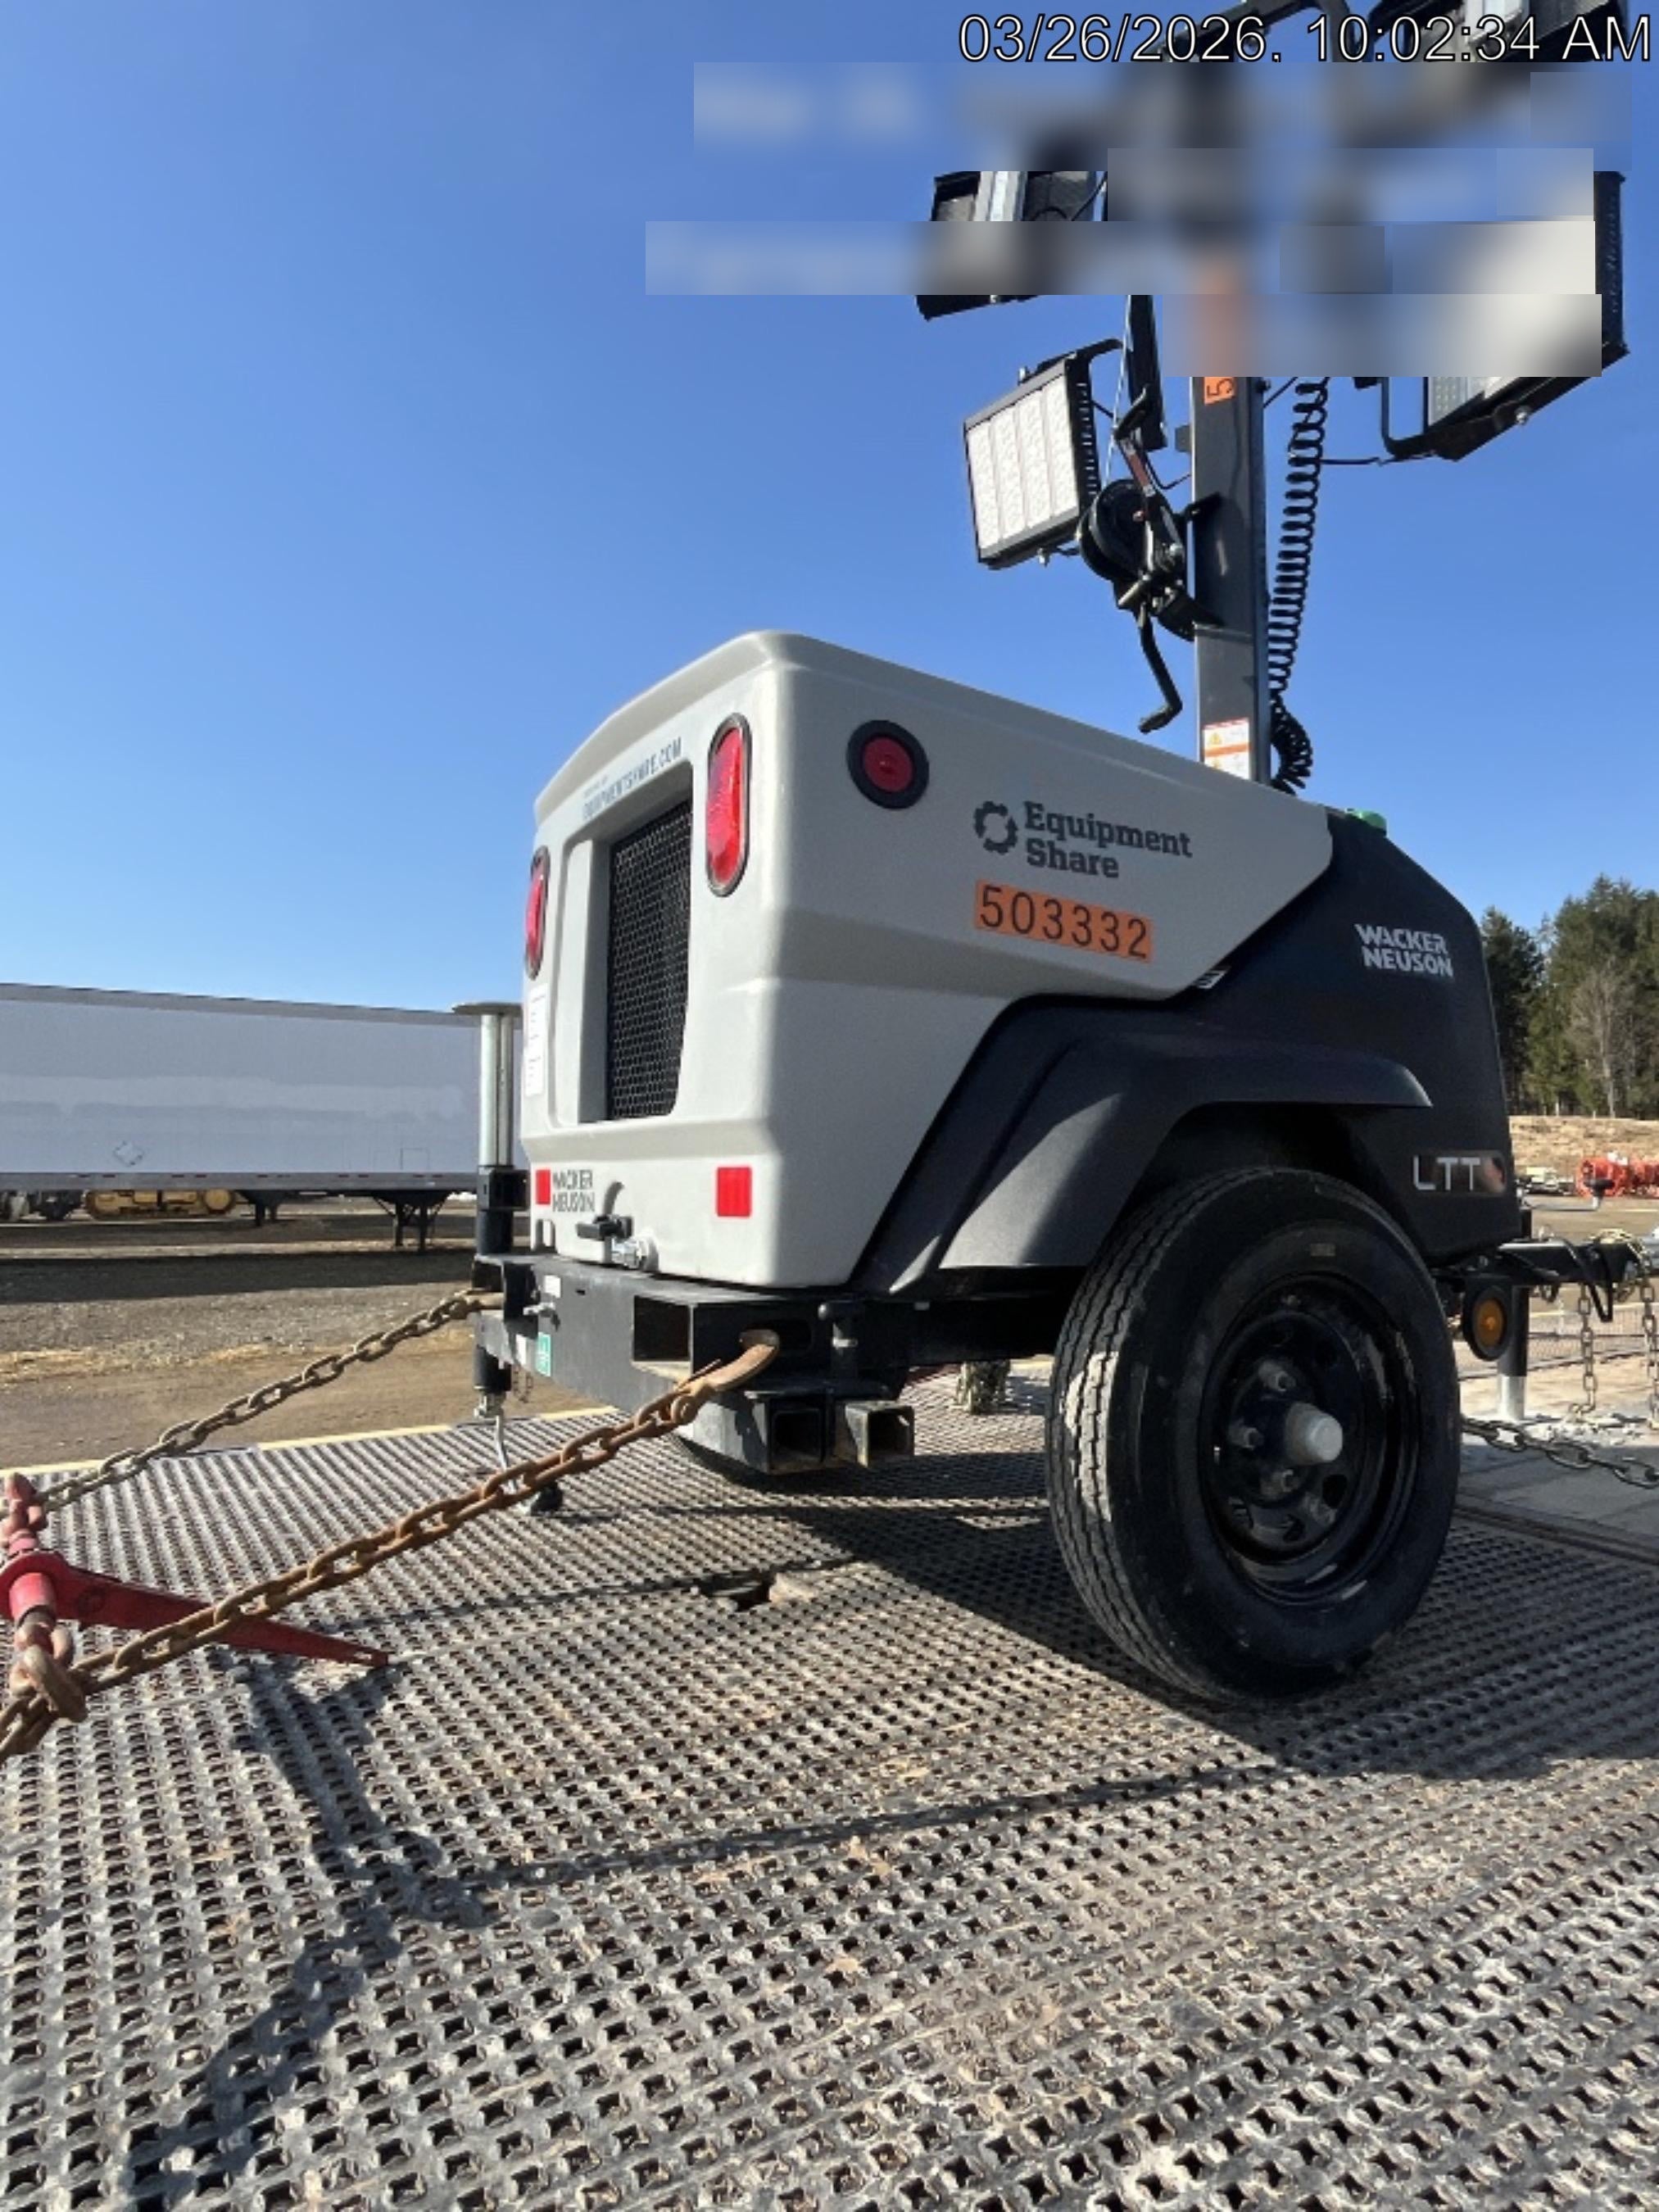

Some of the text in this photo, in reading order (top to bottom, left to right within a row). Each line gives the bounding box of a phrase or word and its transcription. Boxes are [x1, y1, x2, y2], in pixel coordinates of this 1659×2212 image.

[1023, 800, 1193, 859] Equipment
[1026, 837, 1119, 878] Share
[980, 884, 1148, 959] 503332
[1353, 923, 1449, 955] WACKER
[1361, 945, 1453, 977] NEUSON
